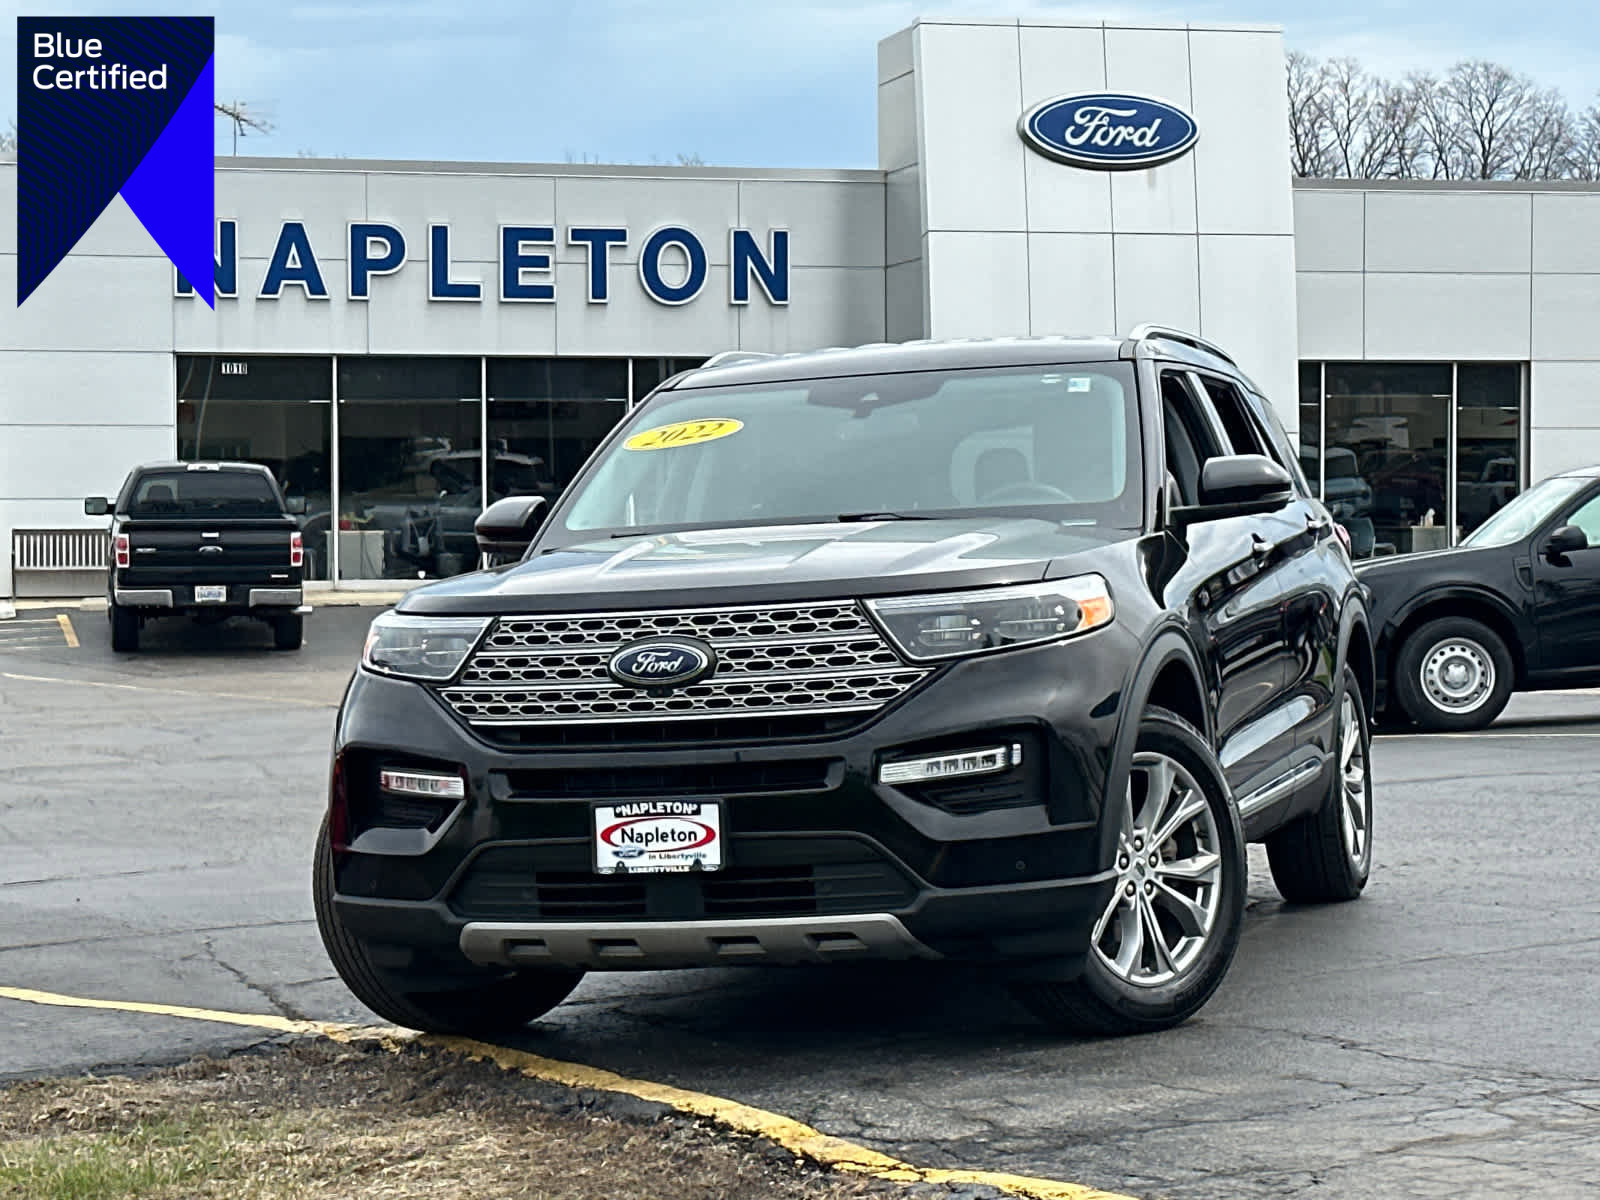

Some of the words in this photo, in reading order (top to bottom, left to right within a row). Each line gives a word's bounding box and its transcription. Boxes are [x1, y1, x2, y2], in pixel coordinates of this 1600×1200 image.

[1065, 106, 1163, 147] Ford
[173, 218, 791, 306] NAPLETON
[641, 422, 726, 446] 2022
[631, 651, 684, 674] Ford
[621, 802, 694, 816] NAPLETON
[620, 827, 698, 847] Napleton
[659, 851, 707, 860] Libertyville
